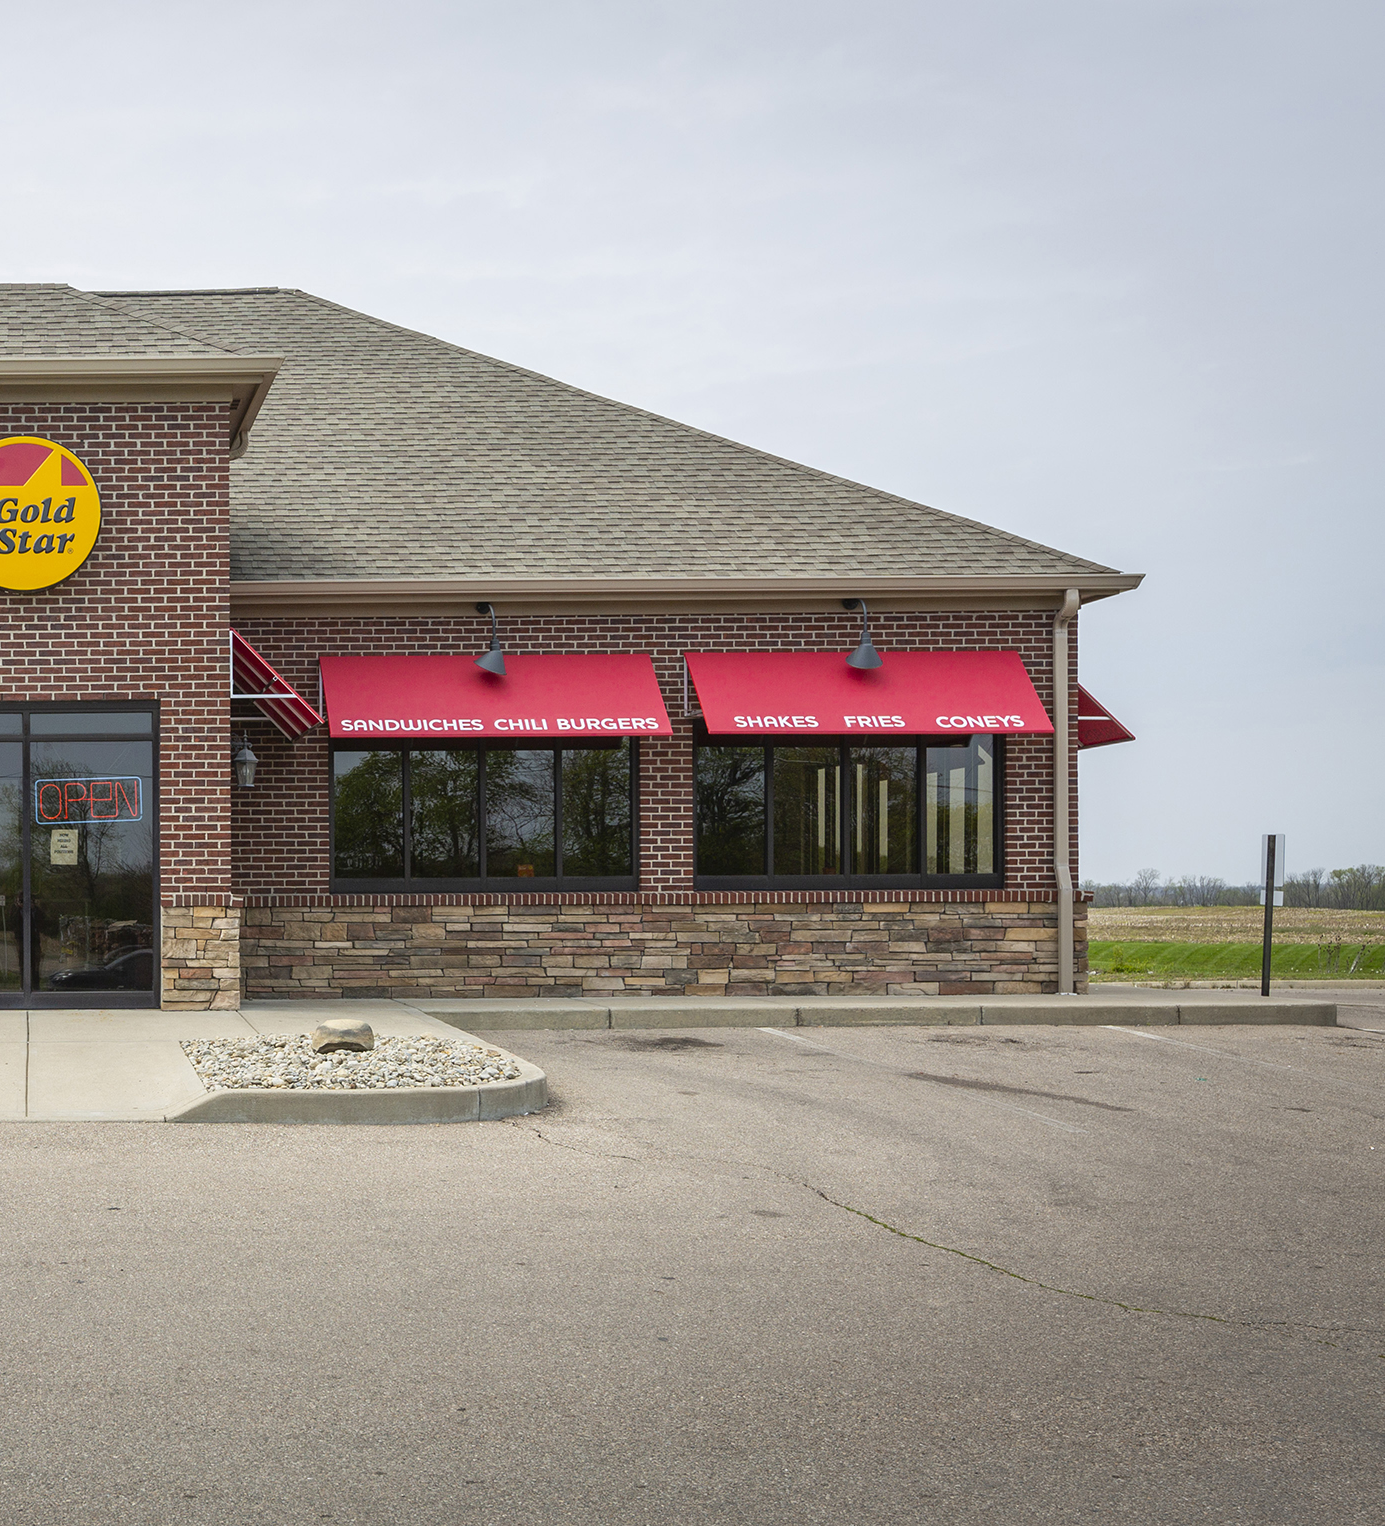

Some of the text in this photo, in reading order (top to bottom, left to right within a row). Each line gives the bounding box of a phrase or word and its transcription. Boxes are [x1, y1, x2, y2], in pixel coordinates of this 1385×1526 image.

[340, 717, 660, 732] SANDWICHES CHILI BURGERS
[733, 715, 1025, 728] SHAKES FRIES CONEYS
[39, 780, 138, 820] OPEN
